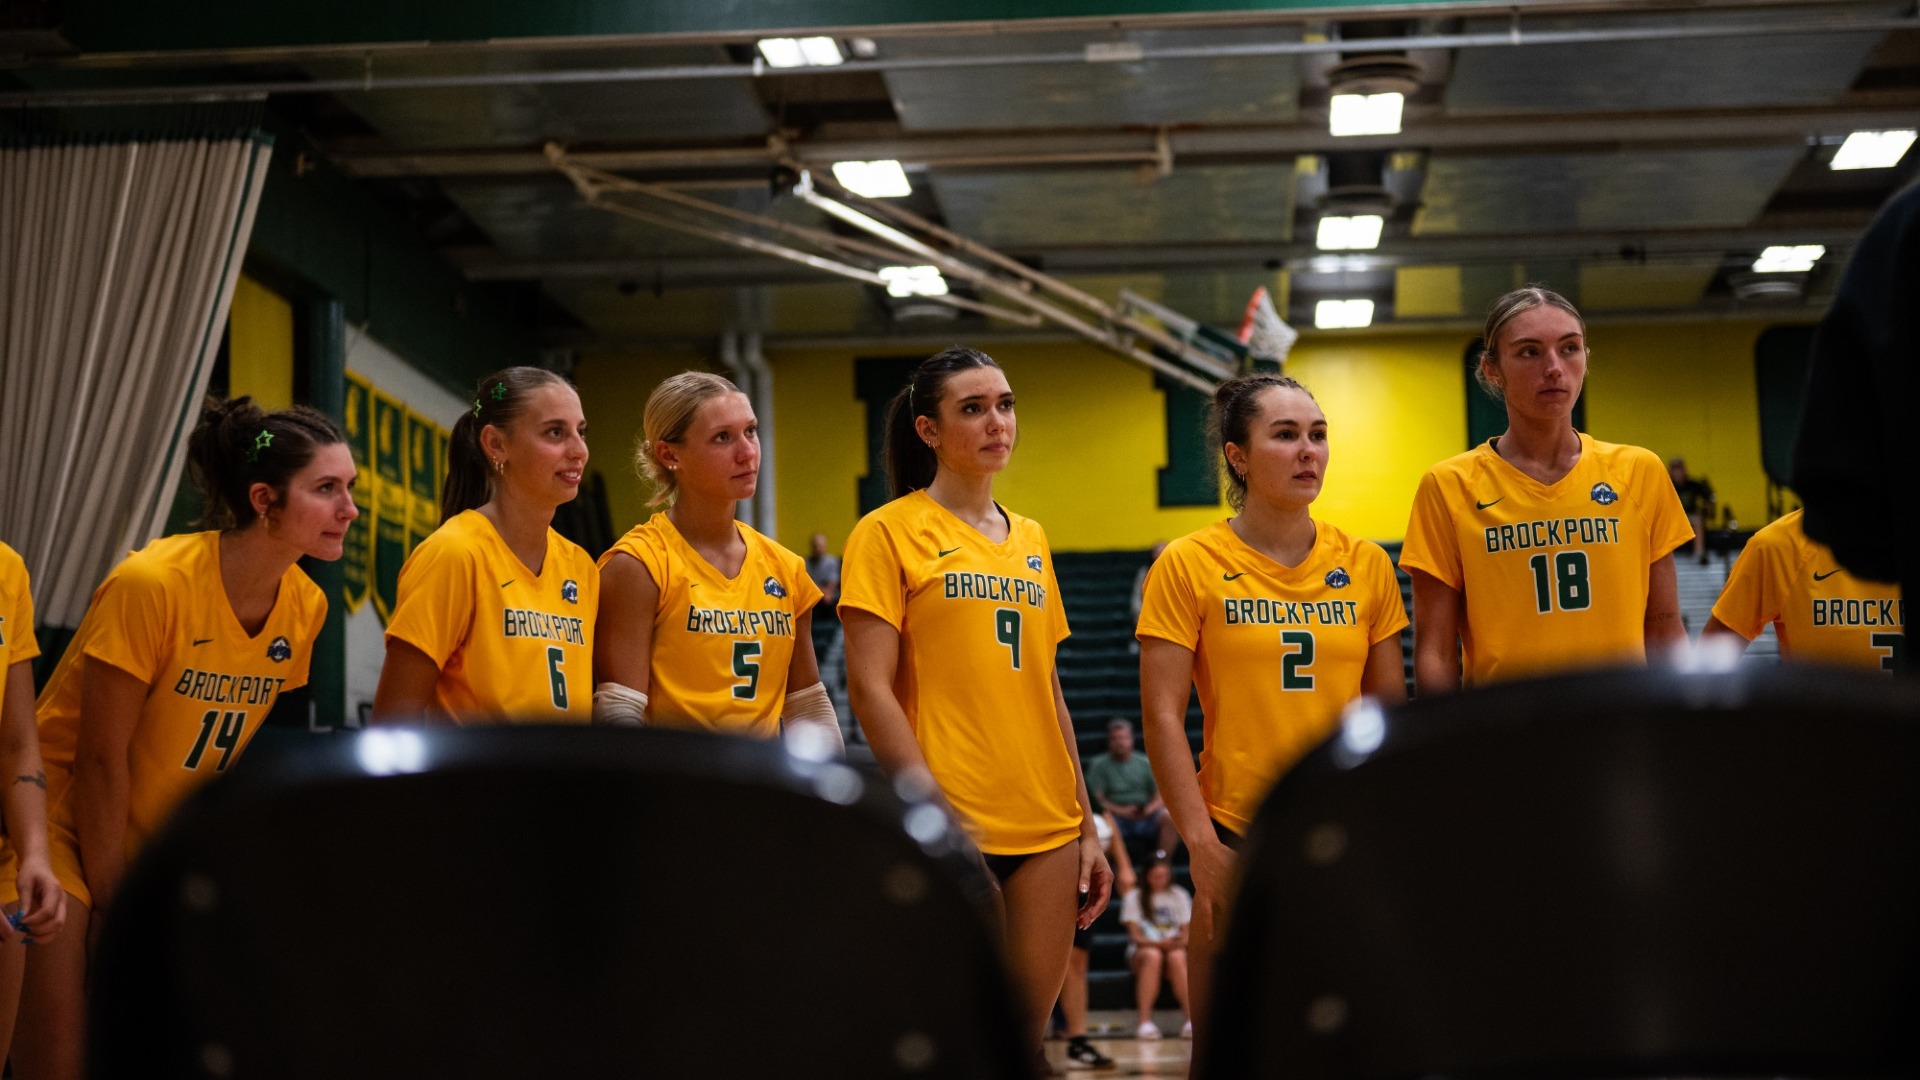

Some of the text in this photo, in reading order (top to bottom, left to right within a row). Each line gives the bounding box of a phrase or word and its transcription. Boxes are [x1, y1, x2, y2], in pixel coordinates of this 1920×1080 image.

[1485, 517, 1620, 554] BROCKPORT
[1224, 597, 1357, 625] BROCKPORT
[1529, 550, 1591, 615] 18
[1812, 598, 1905, 626] BROCK
[503, 607, 585, 646] BROCKPORT
[686, 604, 795, 637] BROCKPORT
[994, 607, 1021, 671] 9
[547, 647, 569, 711] 6
[731, 640, 763, 701] 5
[1280, 630, 1315, 691] 2
[182, 708, 248, 773] 14
